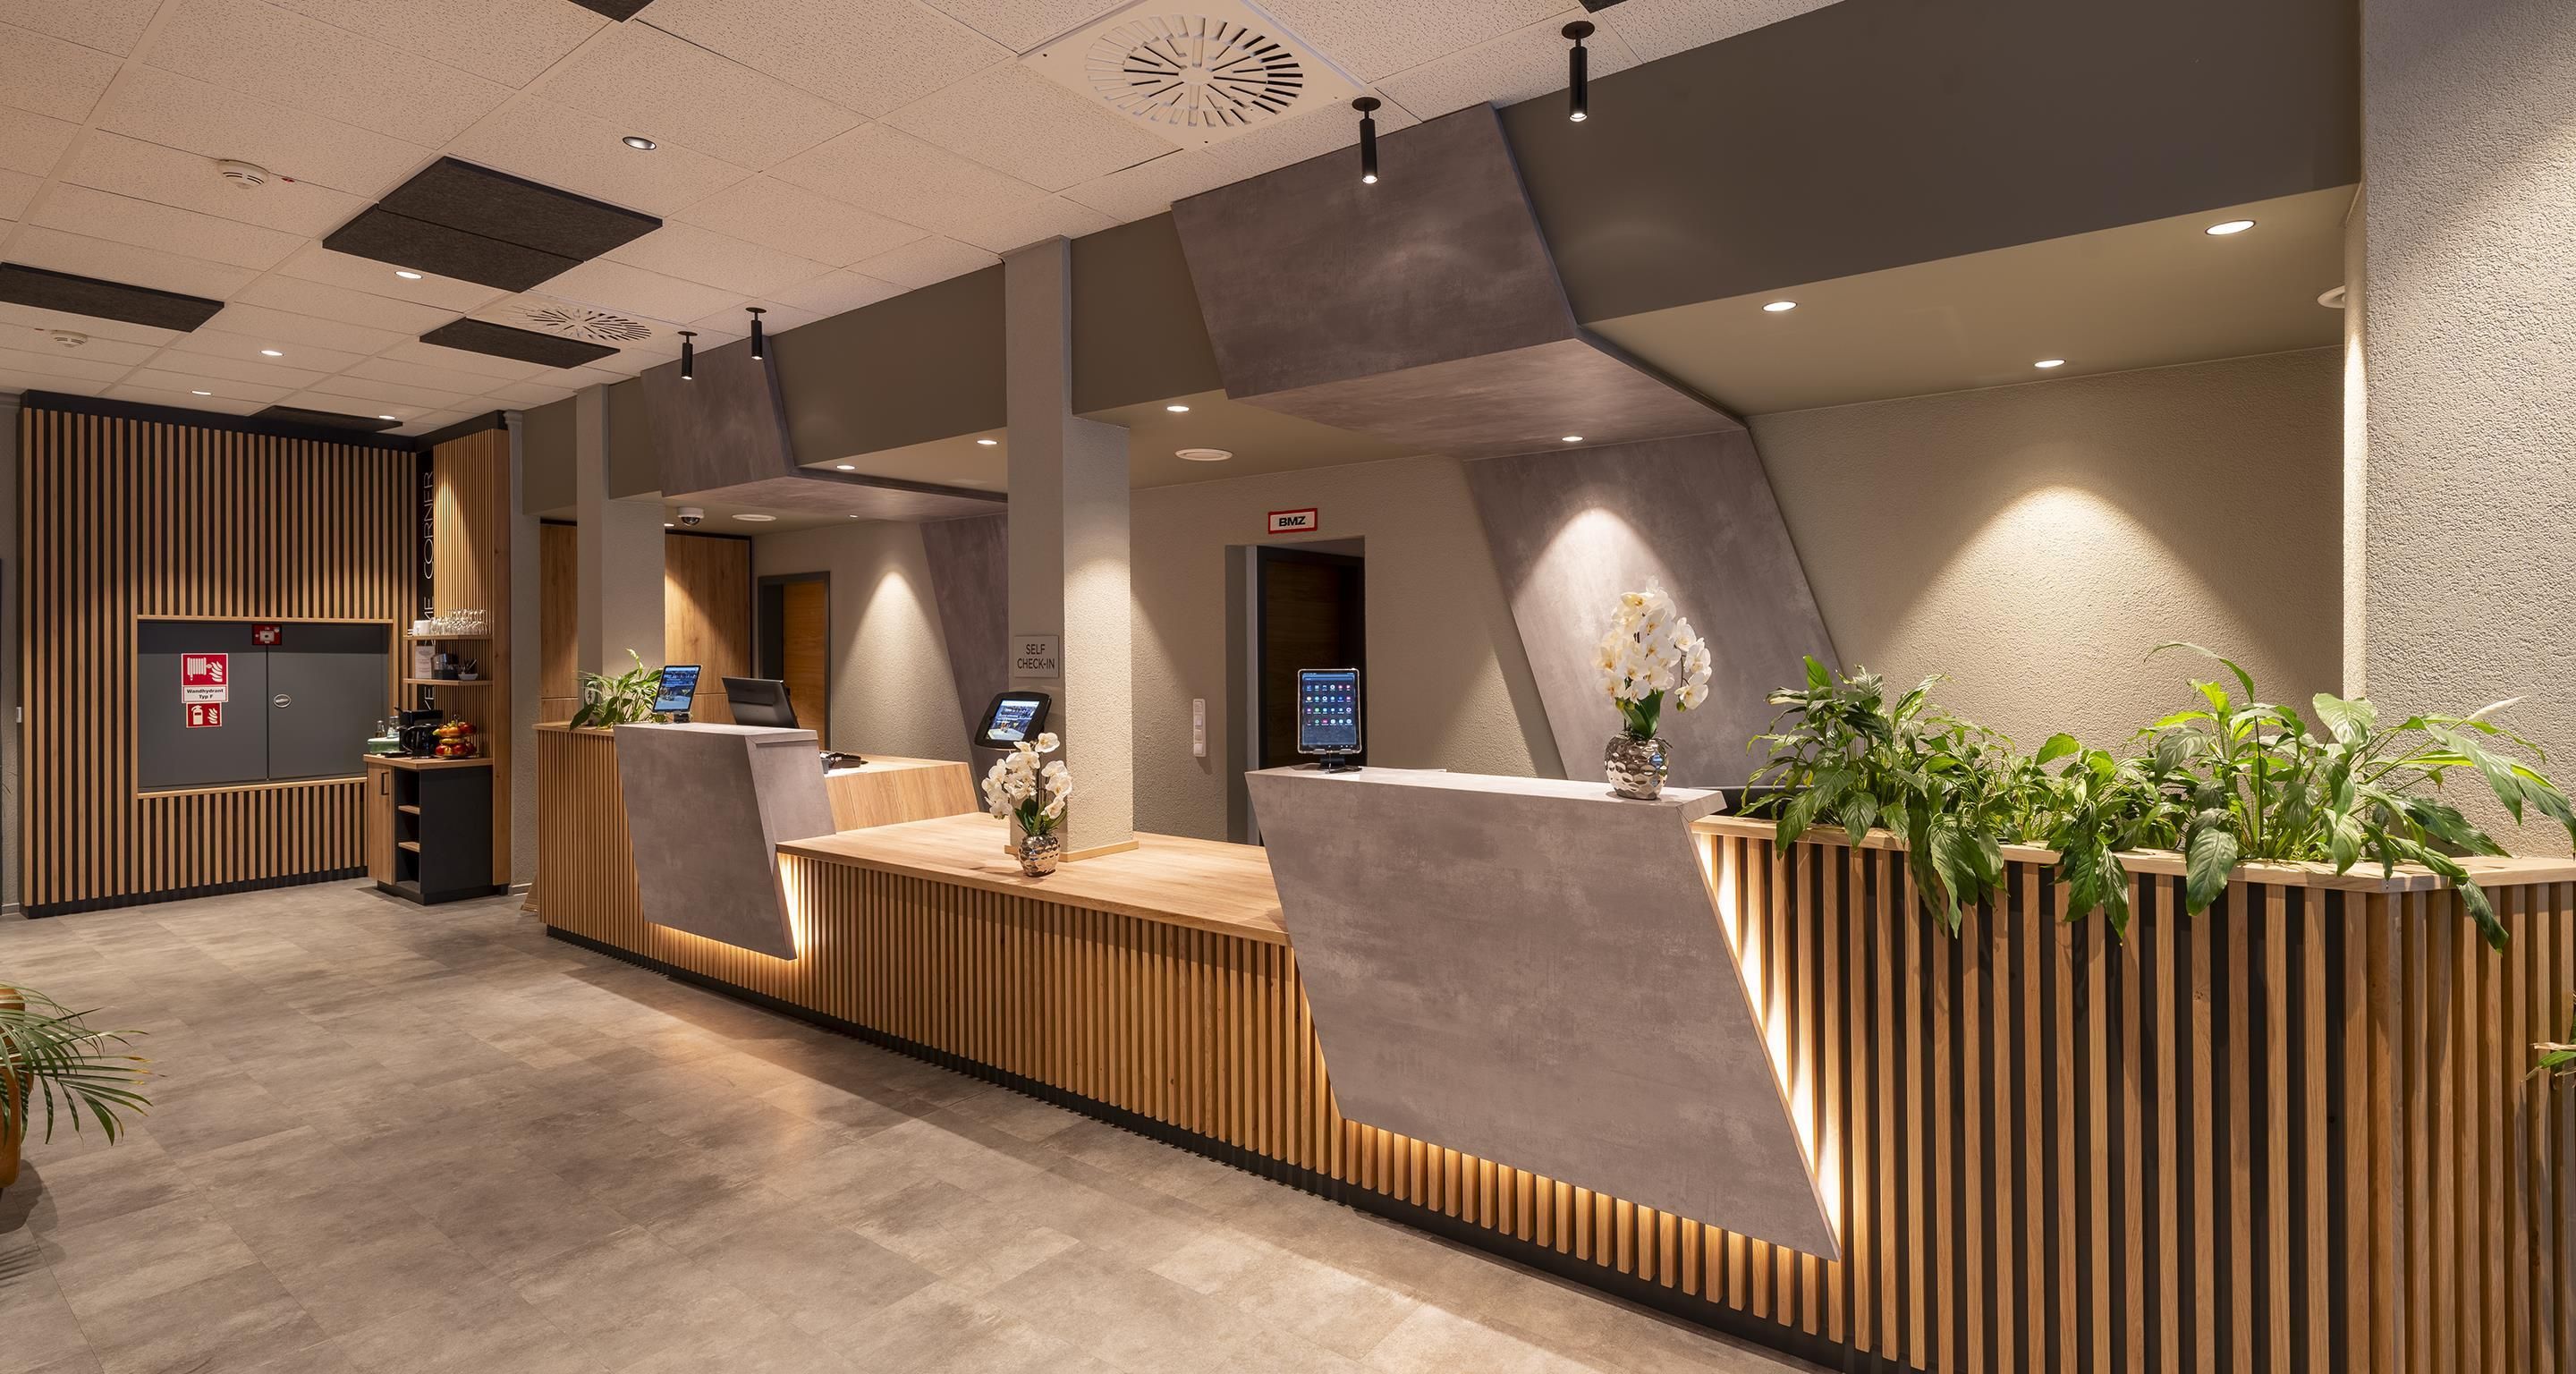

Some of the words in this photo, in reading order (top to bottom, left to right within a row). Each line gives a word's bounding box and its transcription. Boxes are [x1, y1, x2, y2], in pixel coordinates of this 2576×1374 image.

[423, 471, 434, 579] CORNER
[1279, 516, 1306, 527] BMZ
[1025, 643, 1046, 655] SELF
[1016, 657, 1055, 669] CHECK-IN
